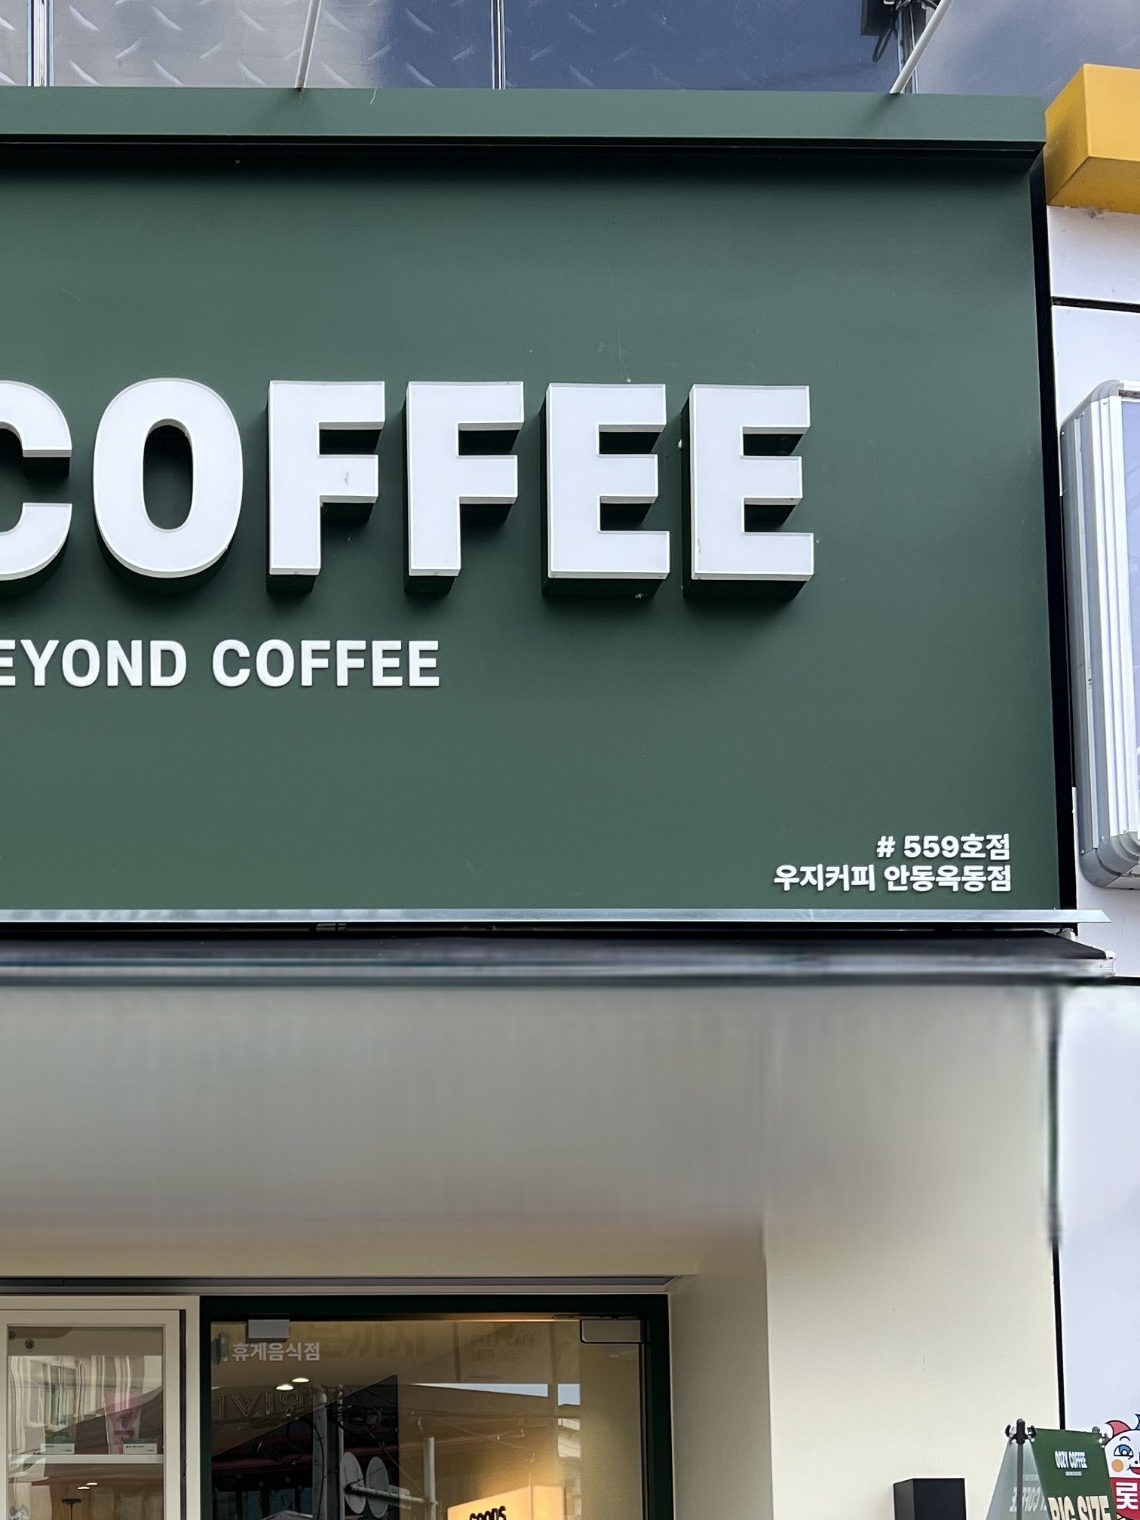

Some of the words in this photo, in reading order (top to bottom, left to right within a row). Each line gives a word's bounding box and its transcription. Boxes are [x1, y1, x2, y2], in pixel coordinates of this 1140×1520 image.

[212, 639, 440, 688] COFFEE
[903, 833, 1012, 863] 559호점
[773, 864, 877, 893] 우지커피
[882, 864, 1013, 893] 안동옥동점
[231, 1342, 320, 1361] 휴게음식점
